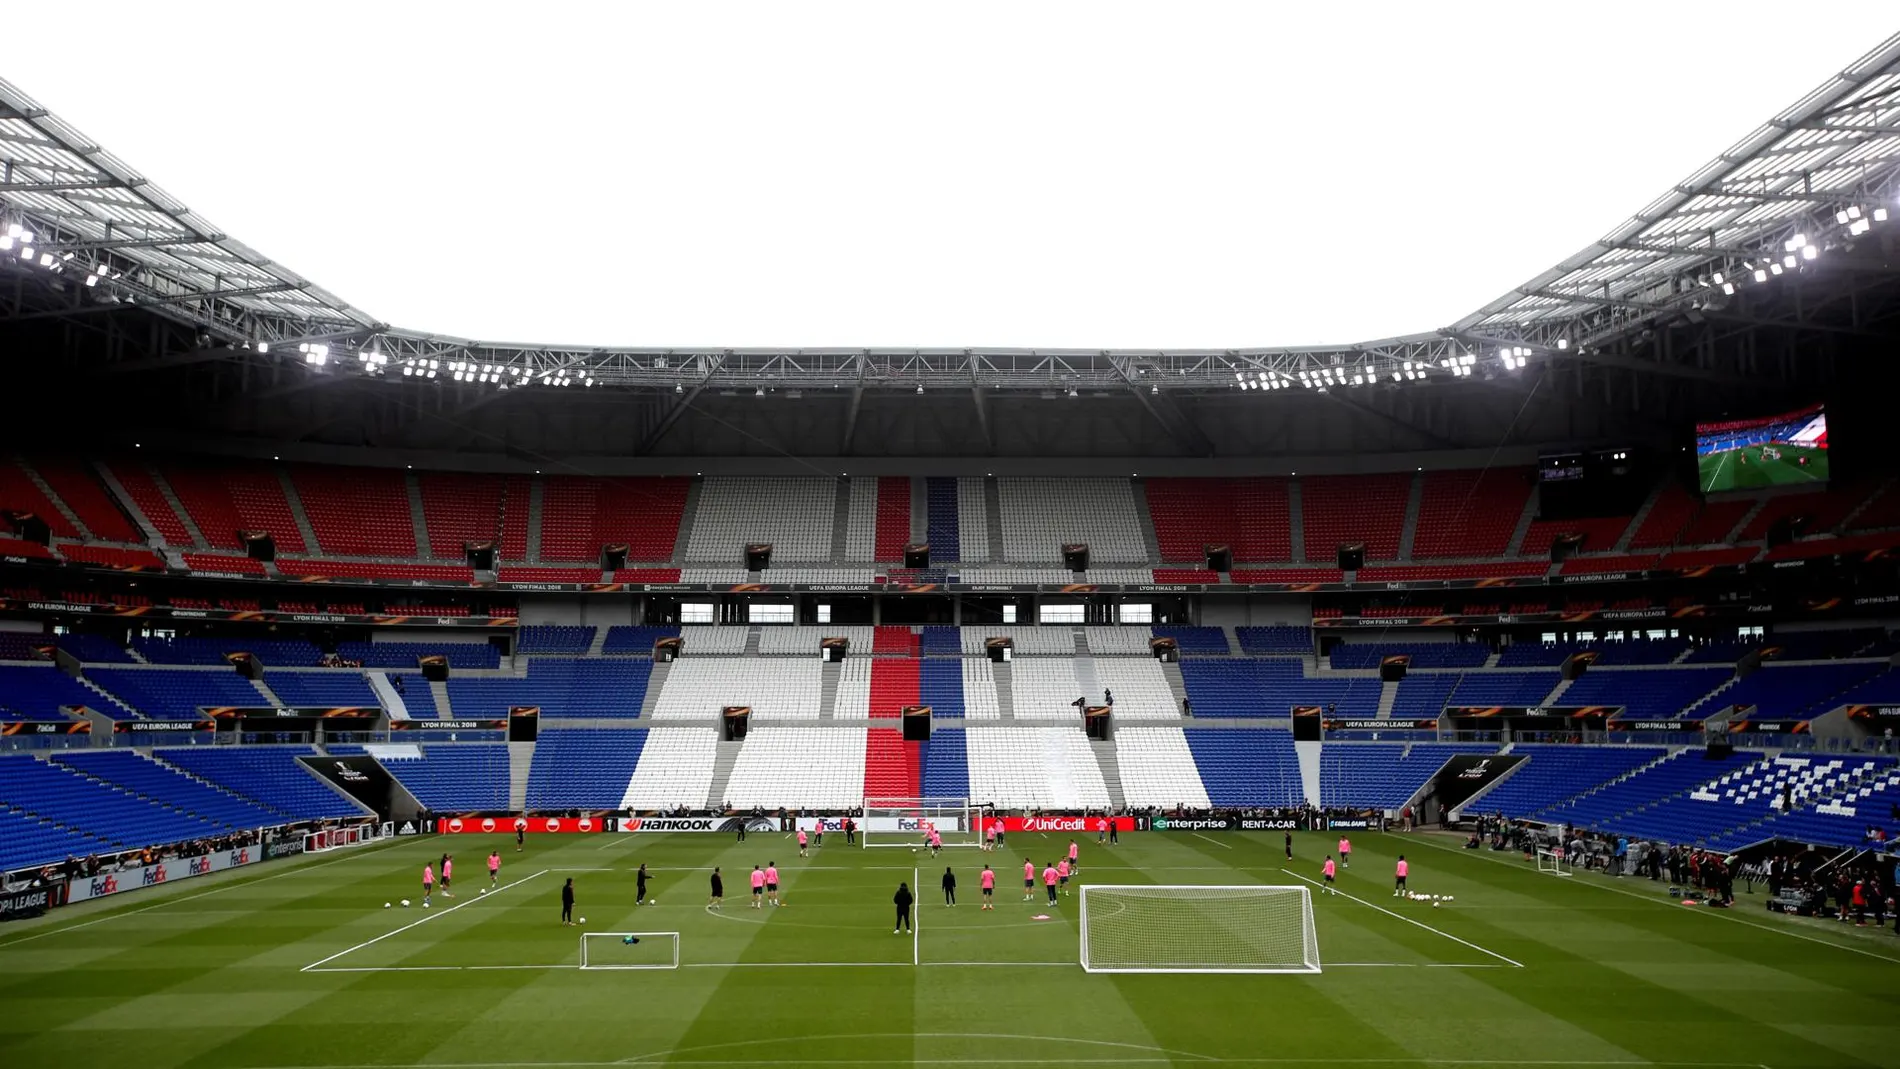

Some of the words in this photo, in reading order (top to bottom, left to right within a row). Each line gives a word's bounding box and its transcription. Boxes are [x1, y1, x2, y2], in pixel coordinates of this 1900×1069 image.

[1564, 575, 1580, 583] UEFA
[28, 602, 44, 610] UEFA
[132, 723, 148, 731] UEFA
[640, 819, 712, 830] HANKOOK
[898, 818, 934, 830] FedEx
[1036, 818, 1085, 830] UniCredit
[1153, 818, 1227, 830] enterprise
[1242, 820, 1296, 829] RENT-A-CAR
[269, 840, 304, 856] enterpris
[230, 849, 249, 867] FedEx
[189, 857, 211, 876] FedEx
[143, 865, 167, 885] FedEx
[90, 875, 118, 897] FedEx
[15, 892, 47, 910] LEAGUE
